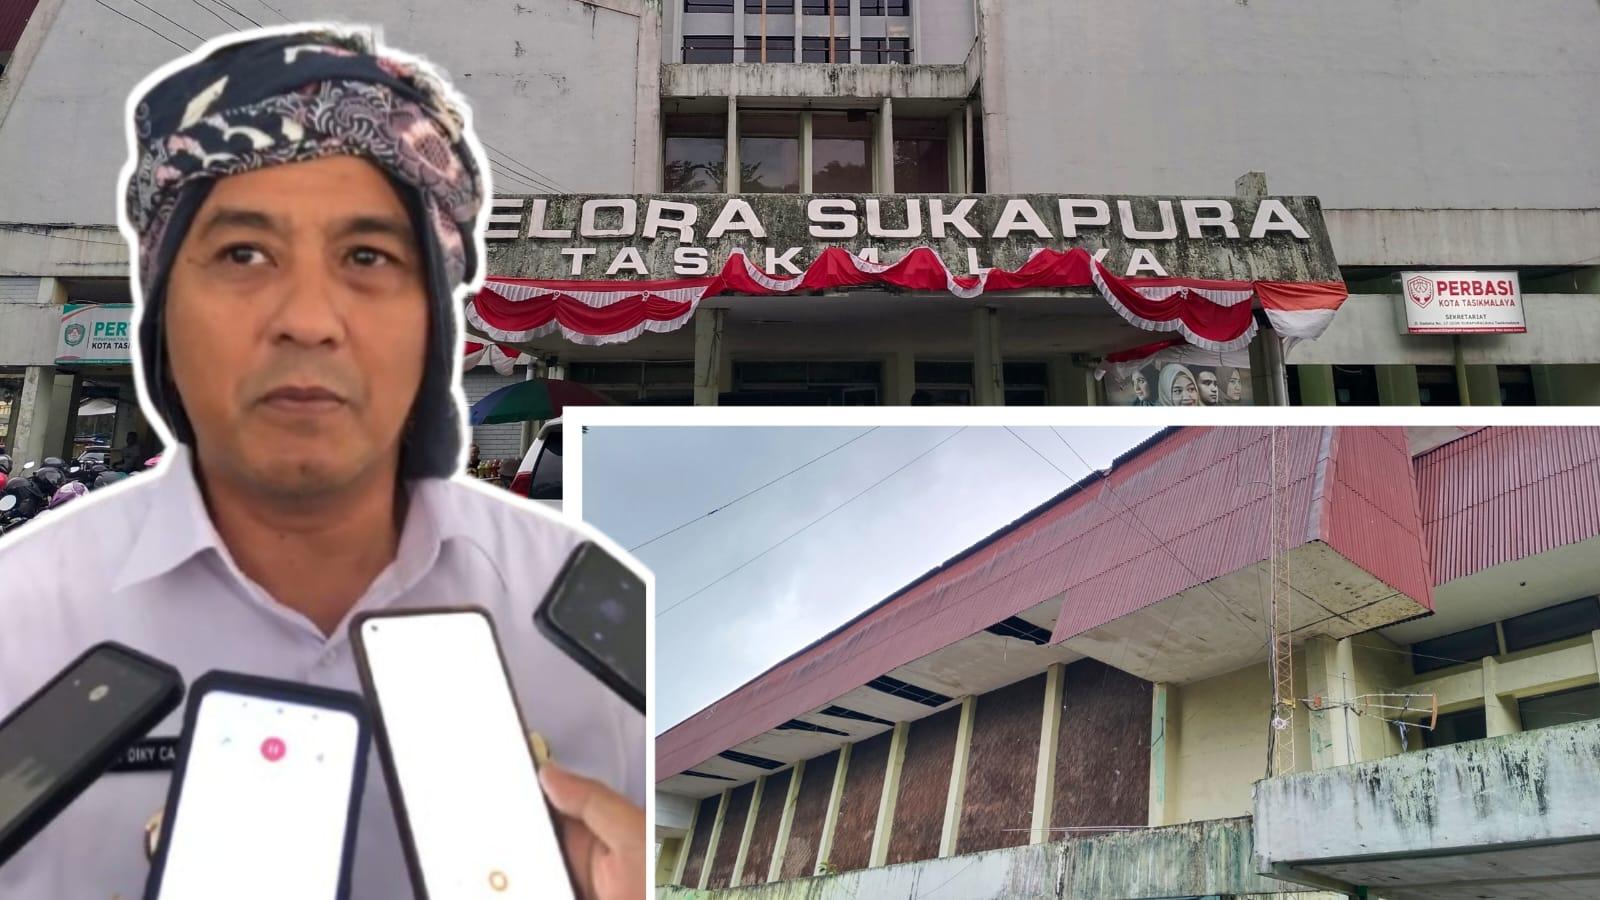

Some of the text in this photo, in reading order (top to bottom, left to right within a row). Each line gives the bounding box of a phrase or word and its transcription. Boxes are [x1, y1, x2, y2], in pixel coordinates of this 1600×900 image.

[807, 198, 1310, 240] SUKAPURA
[1437, 280, 1514, 296] PERBASI
[1439, 299, 1515, 307] KOTA TASIKMALAYA
[94, 322, 130, 336] PER
